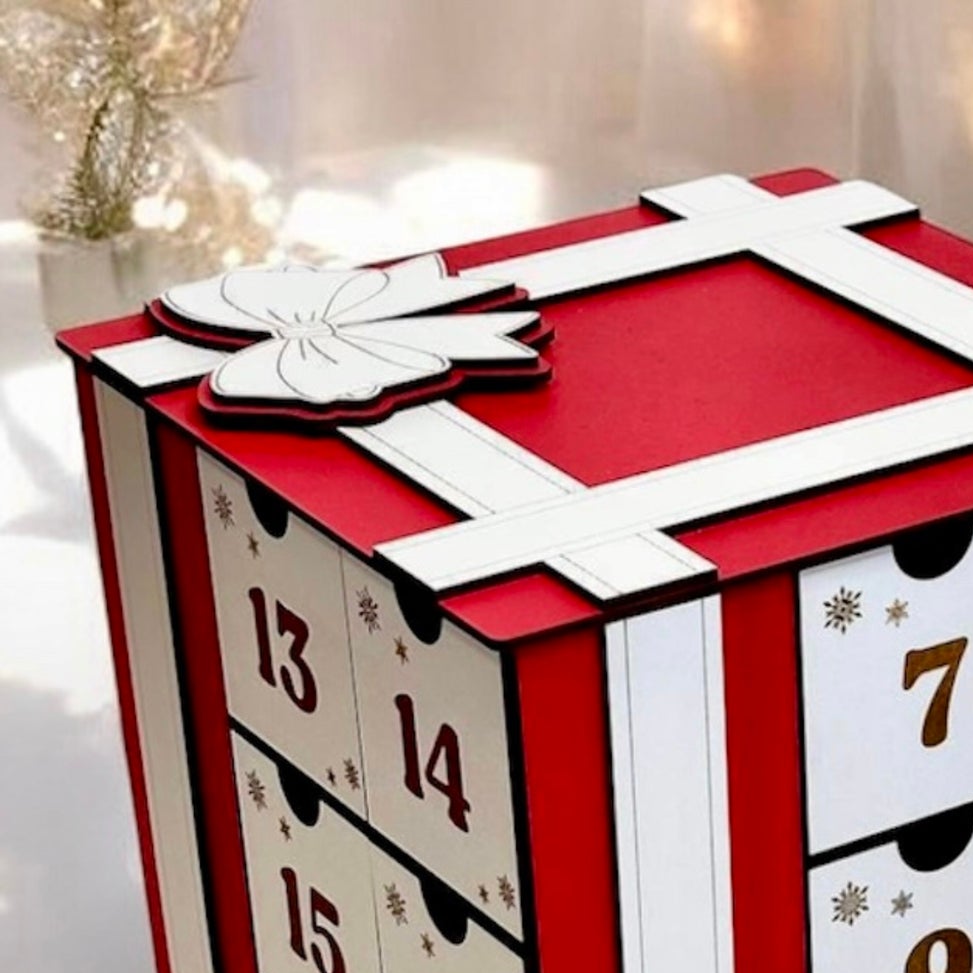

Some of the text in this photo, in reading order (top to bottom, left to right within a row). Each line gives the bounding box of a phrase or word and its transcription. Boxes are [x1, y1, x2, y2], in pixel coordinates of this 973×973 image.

[249, 587, 317, 713] 13
[903, 637, 968, 747] 7
[395, 694, 470, 832] 14
